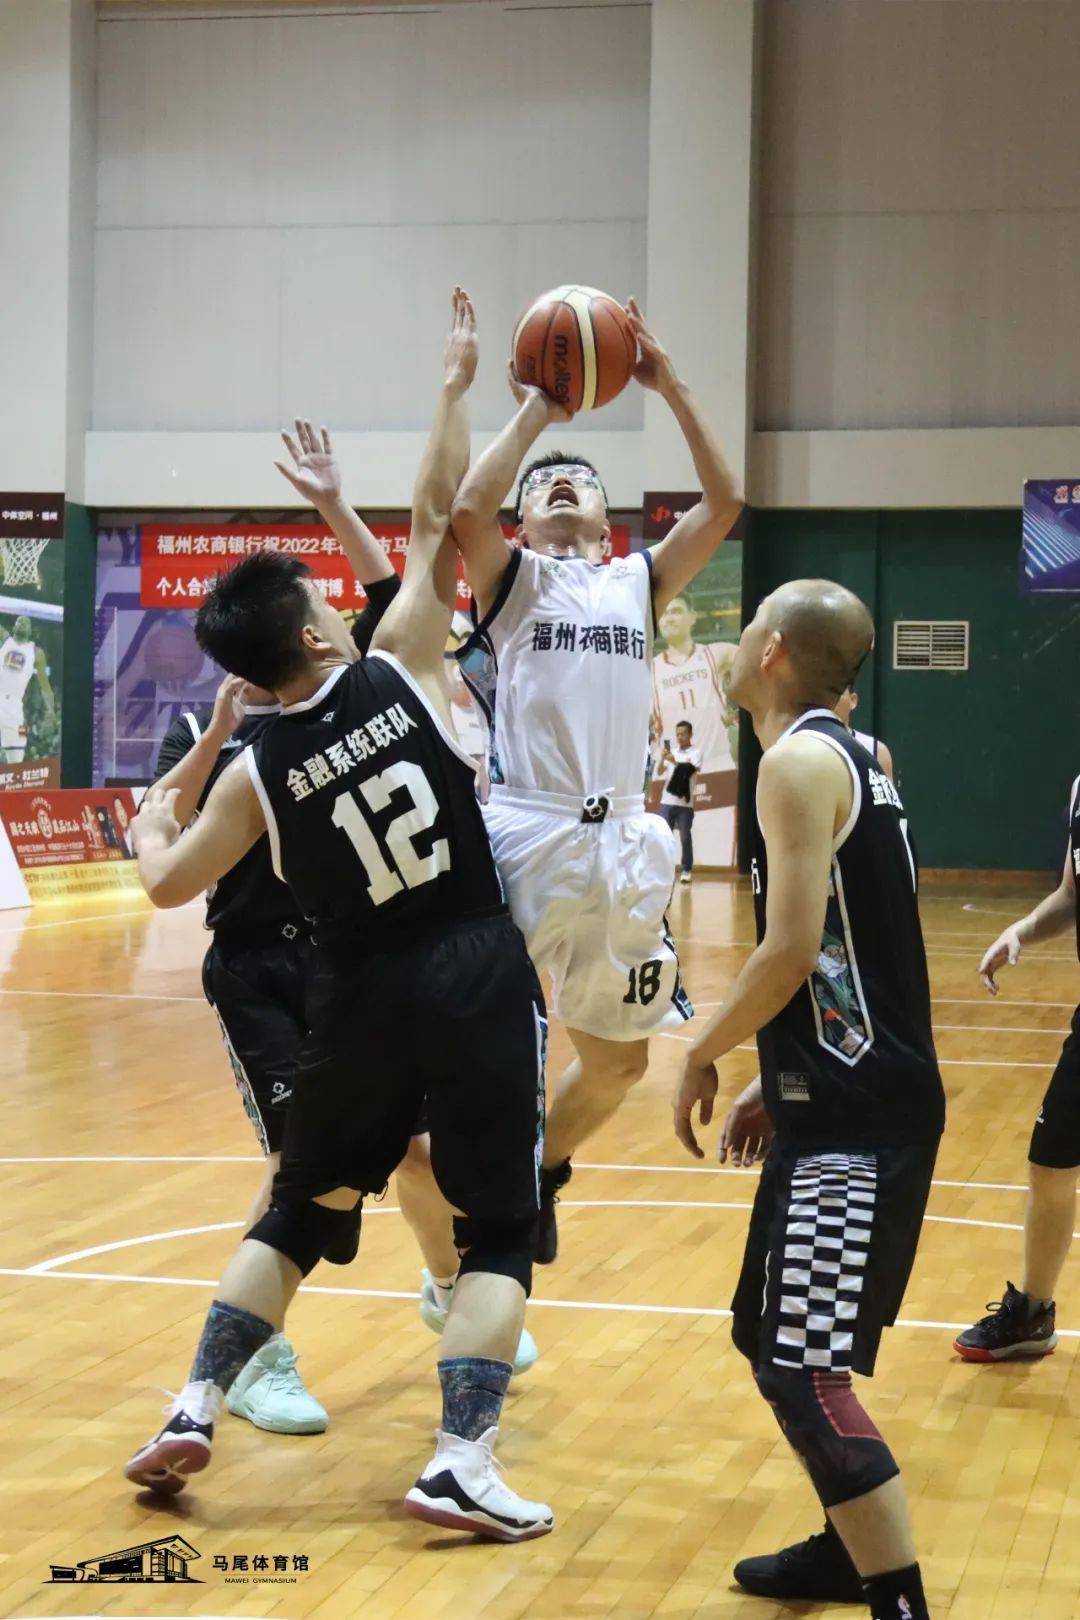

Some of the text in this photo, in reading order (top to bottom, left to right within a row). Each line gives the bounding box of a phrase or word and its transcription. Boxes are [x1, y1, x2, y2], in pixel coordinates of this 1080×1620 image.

[679, 688, 695, 710] 11
[286, 702, 418, 802] 金融系统联队
[331, 760, 450, 906] 12
[623, 959, 663, 1006] 18
